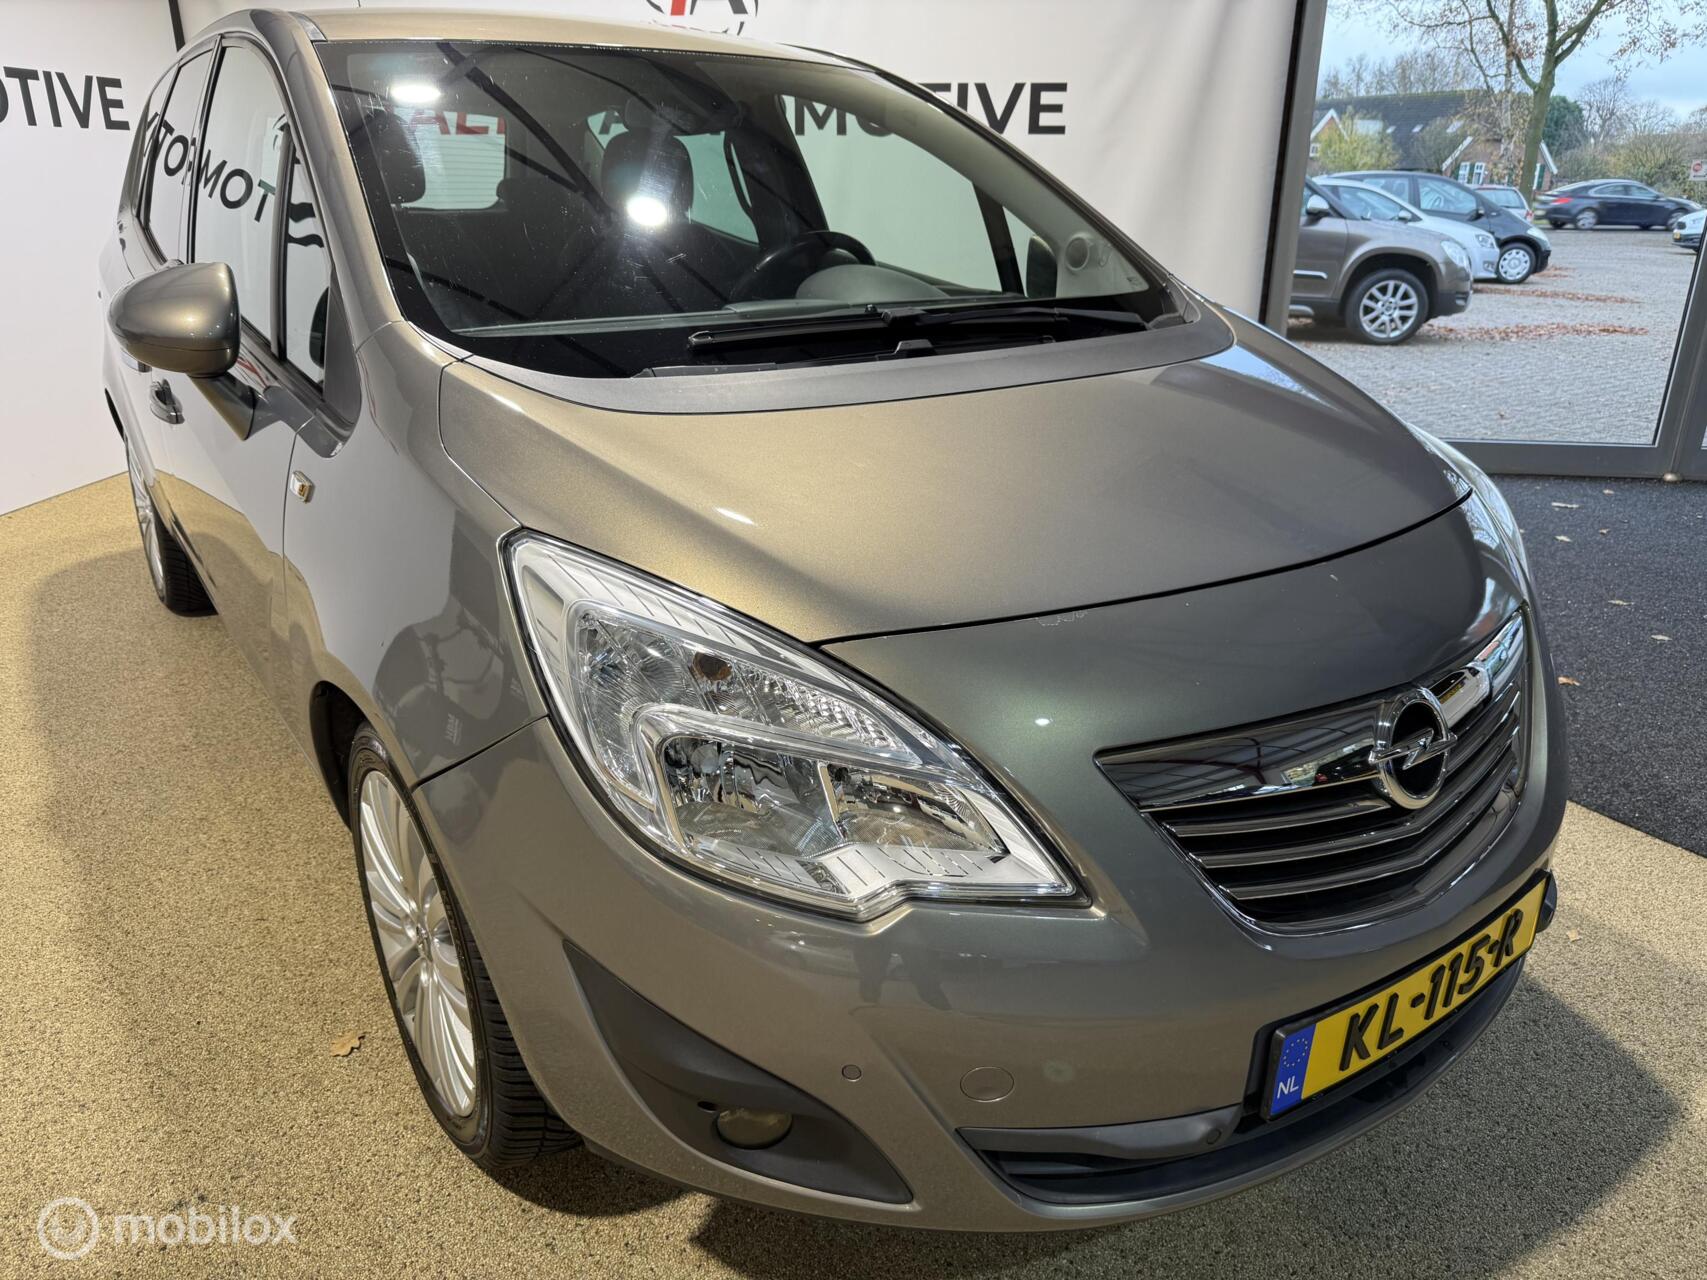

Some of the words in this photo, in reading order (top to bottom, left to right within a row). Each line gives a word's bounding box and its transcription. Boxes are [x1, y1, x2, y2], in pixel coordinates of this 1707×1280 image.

[0, 66, 130, 131] TIVE
[1338, 908, 1524, 1072] KL-115-R
[1276, 1074, 1300, 1099] NL
